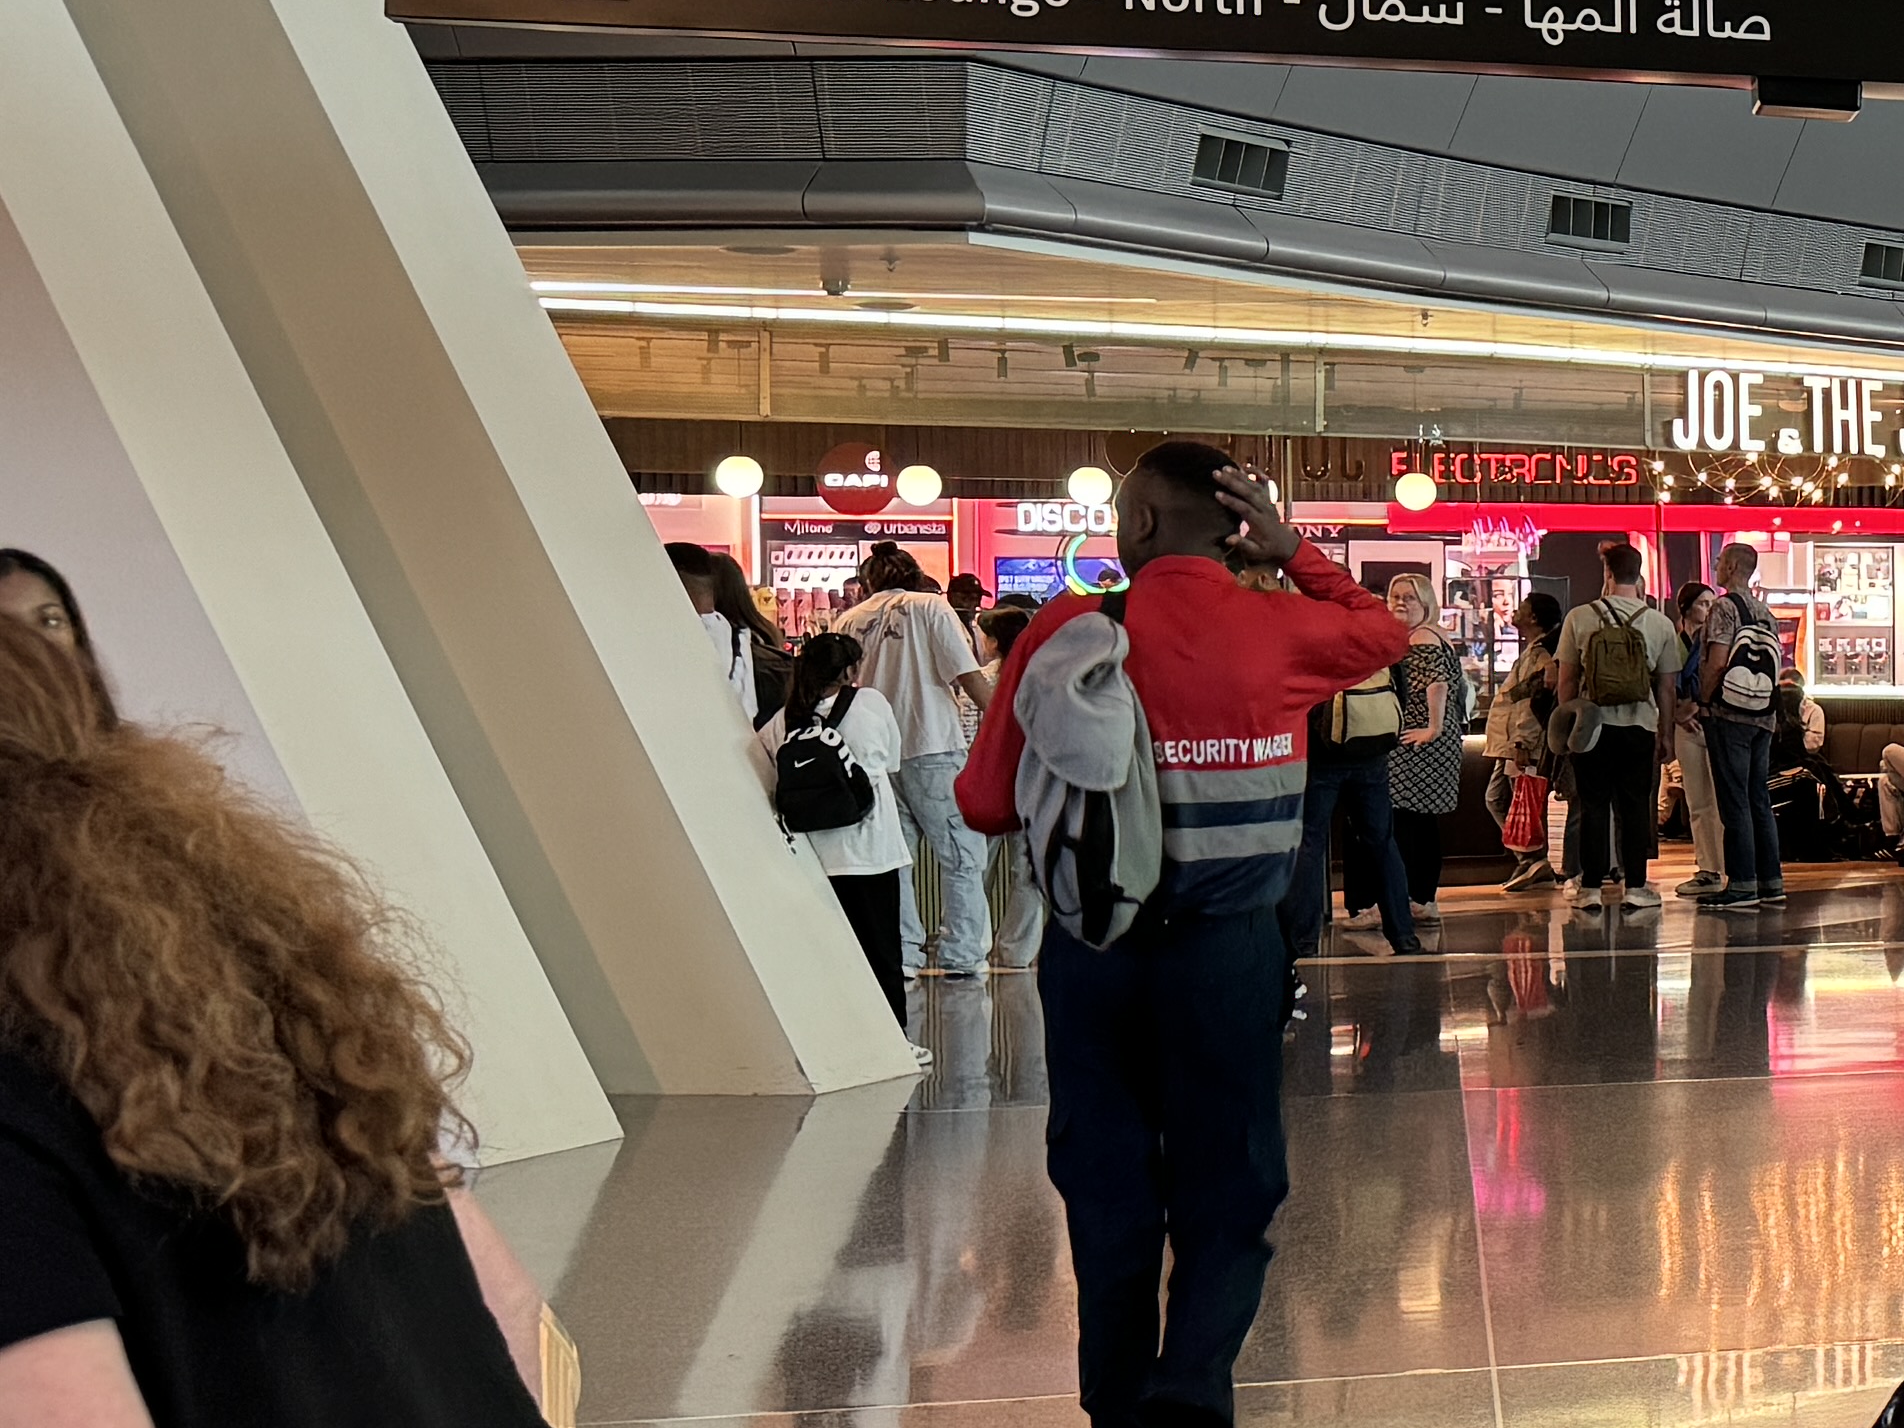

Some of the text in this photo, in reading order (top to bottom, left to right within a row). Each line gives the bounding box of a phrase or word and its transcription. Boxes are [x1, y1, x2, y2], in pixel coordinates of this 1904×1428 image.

[1672, 369, 1766, 451] JOE
[1777, 428, 1803, 455] &
[1803, 375, 1886, 458] THE
[1154, 738, 1250, 764] SECURITY
